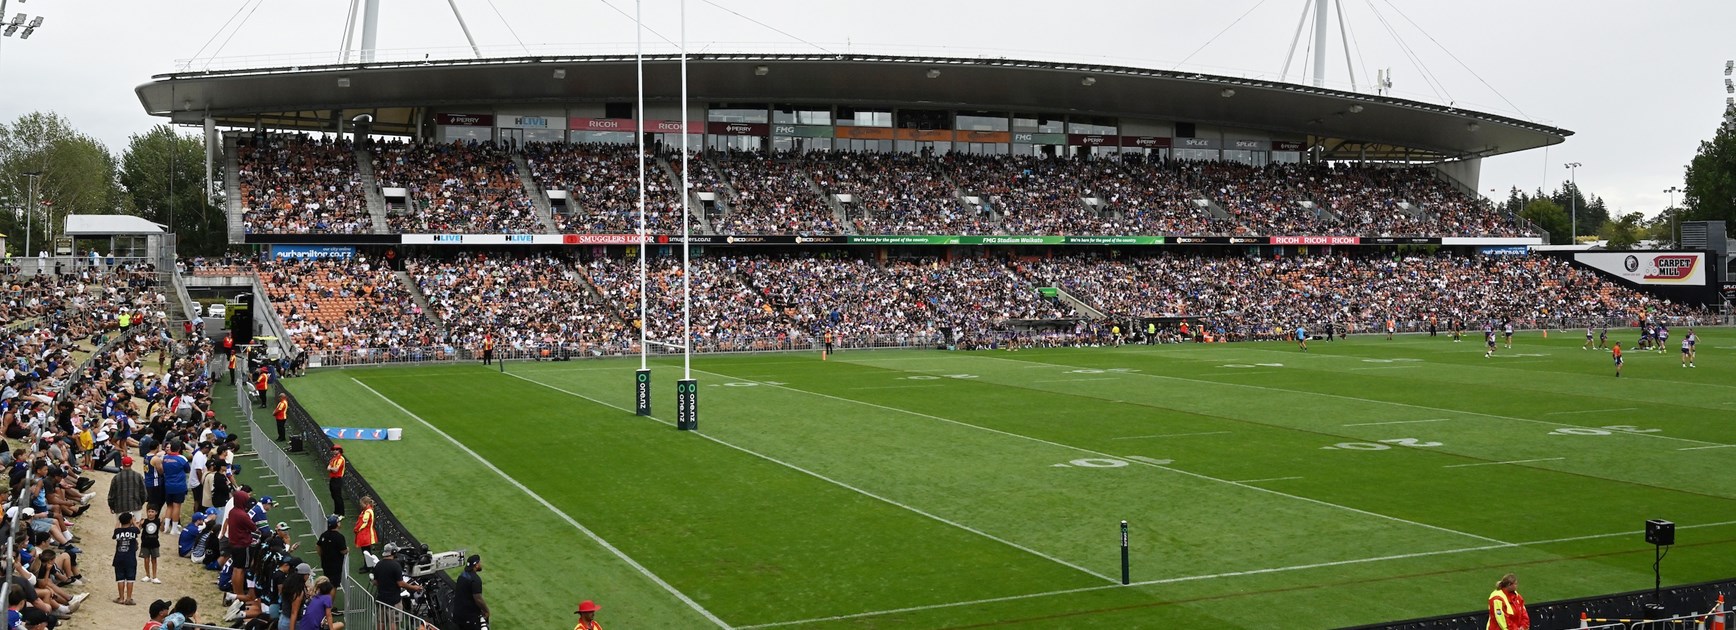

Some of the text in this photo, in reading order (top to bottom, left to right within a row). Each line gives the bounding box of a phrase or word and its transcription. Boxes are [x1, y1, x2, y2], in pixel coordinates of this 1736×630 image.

[589, 120, 618, 128] RICOH
[775, 126, 795, 134] FMG
[579, 235, 655, 243] SMUGGLERS LIQOR
[1659, 259, 1691, 268] CARPET
[1659, 268, 1680, 276] MILL
